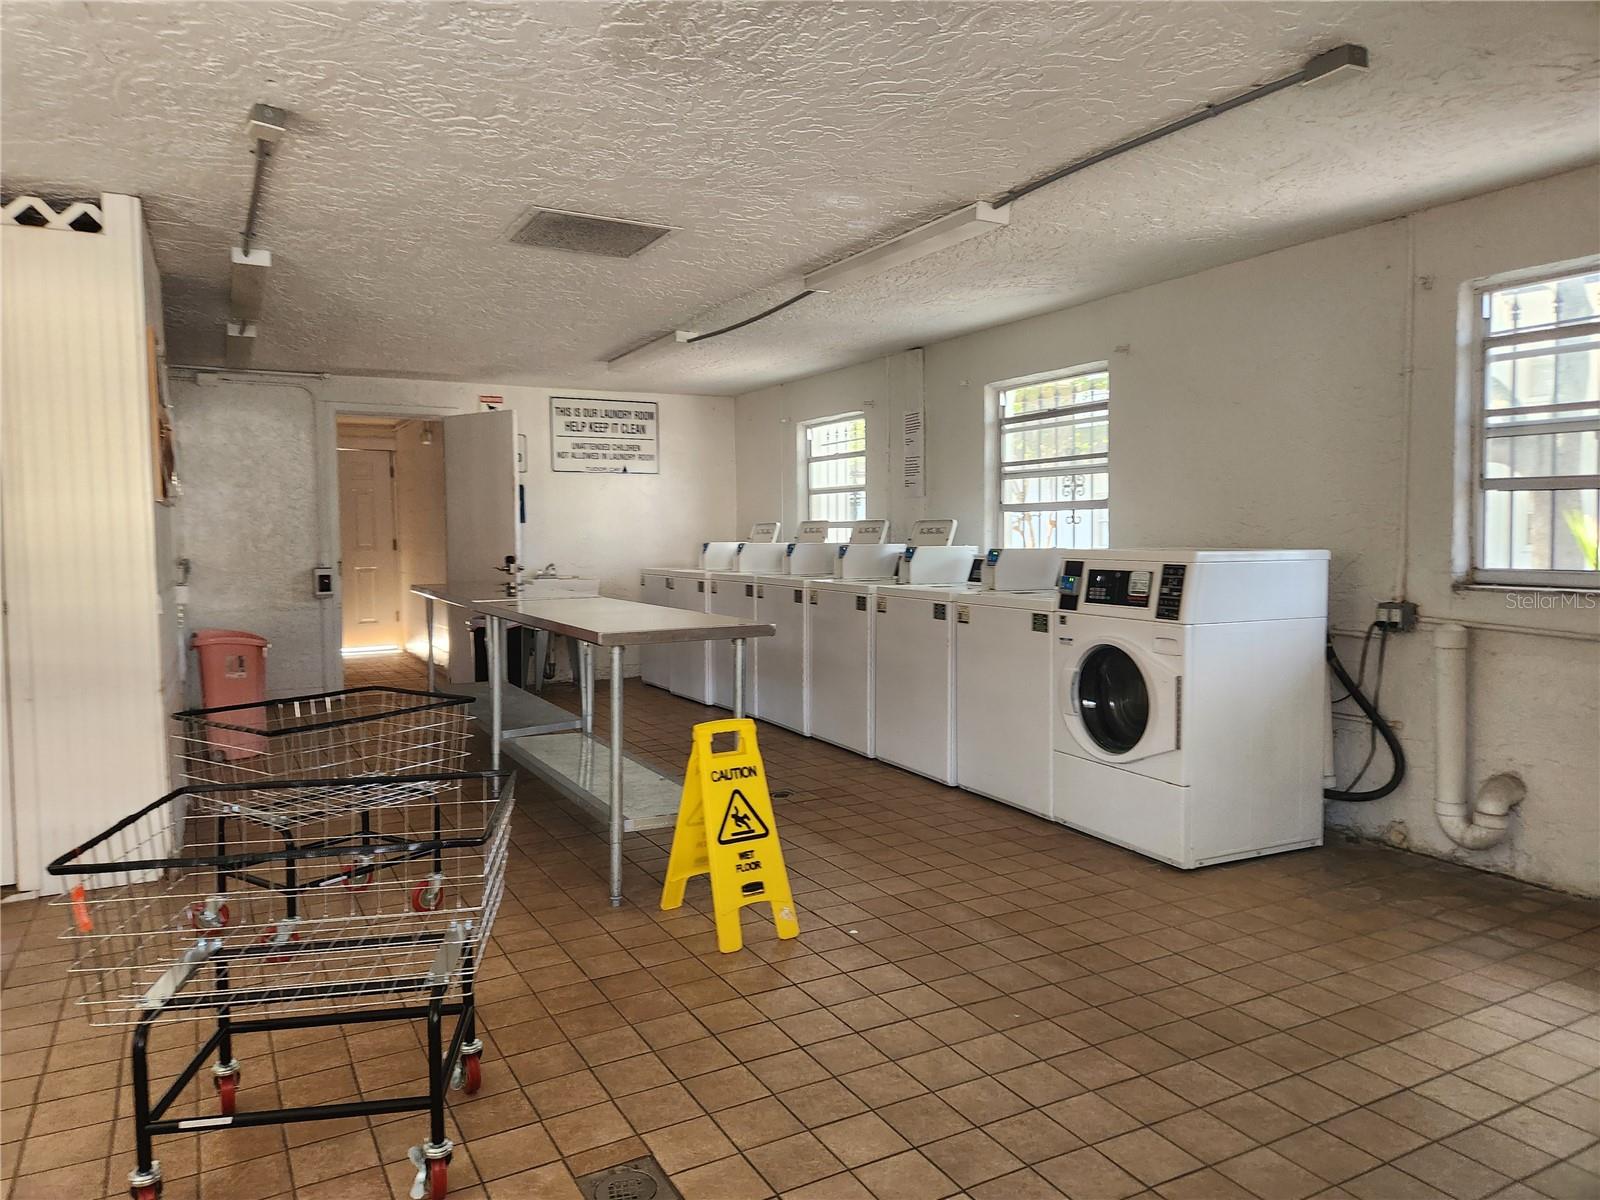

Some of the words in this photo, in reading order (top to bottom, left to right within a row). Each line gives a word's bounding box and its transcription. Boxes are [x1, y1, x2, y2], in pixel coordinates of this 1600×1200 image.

[555, 406, 571, 417] THIS
[573, 407, 581, 417] IS
[583, 407, 598, 418] OUR
[600, 408, 632, 420] LAUNDRY
[633, 410, 654, 421] ROOM
[565, 420, 587, 432] HELP
[588, 421, 609, 433] KEEP
[611, 422, 619, 434] IT
[621, 423, 647, 435] CLEAN
[571, 442, 610, 451] UNATTENDED
[612, 443, 641, 452] CHILDREN
[557, 451, 569, 459] NOT
[571, 452, 599, 460] ALLOWED
[602, 452, 607, 460] IN
[609, 453, 635, 461] LAUNDRY
[638, 453, 655, 461] ROOM
[711, 765, 757, 782] CAUTION
[738, 849, 755, 860] WET
[735, 860, 762, 873] FLOOR
